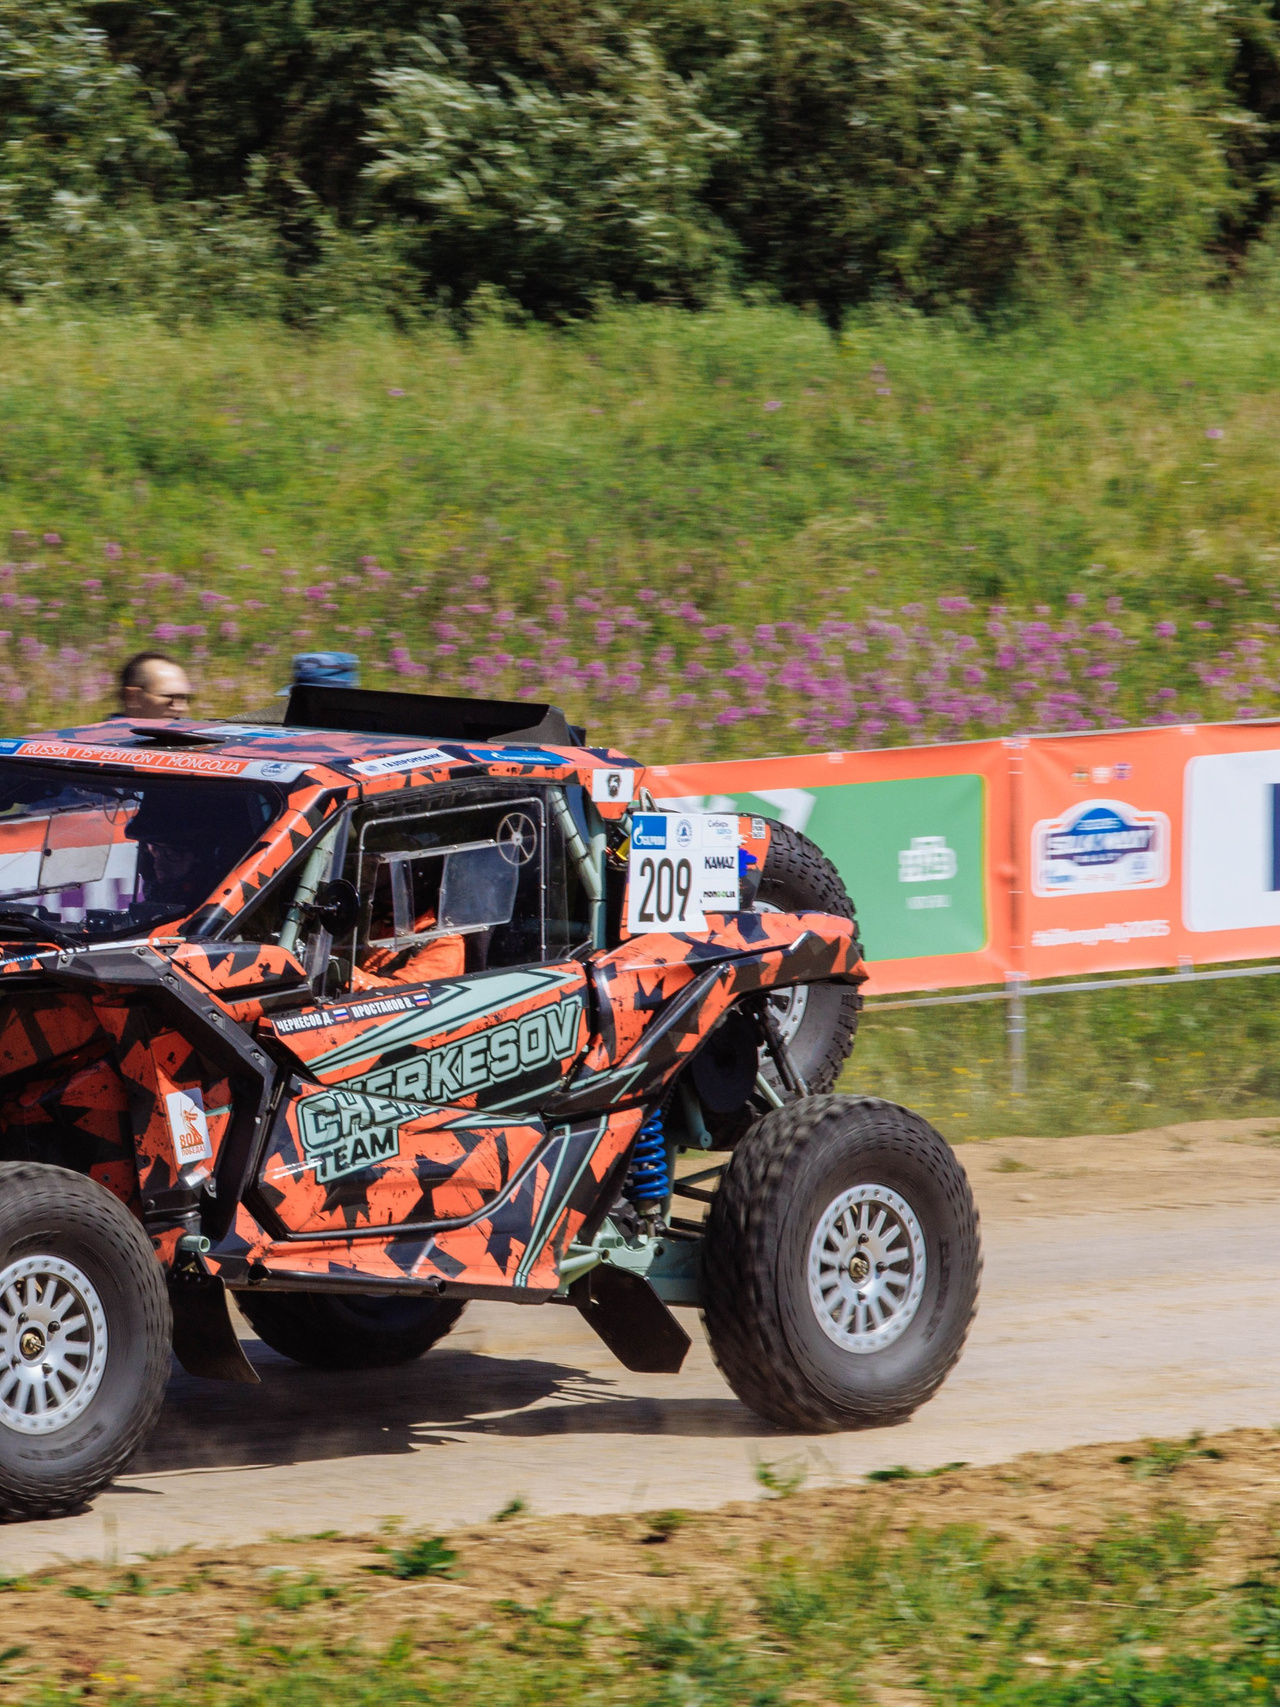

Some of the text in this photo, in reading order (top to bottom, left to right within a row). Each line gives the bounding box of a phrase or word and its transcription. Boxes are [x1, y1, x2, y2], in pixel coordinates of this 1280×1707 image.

[23, 744, 69, 758] RUSSIA
[101, 751, 156, 764] EDITION
[166, 757, 240, 773] MONGOLIA
[704, 856, 735, 870] KAMAZ
[638, 857, 693, 923] 209
[350, 998, 406, 1018] ПРОСТАКОВ
[276, 1011, 334, 1032] ЧЕРКЕСОВ Д.
[301, 1001, 588, 1148] CHERKESOV
[180, 1132, 193, 1147] 80
[316, 1126, 396, 1178] TEAM
